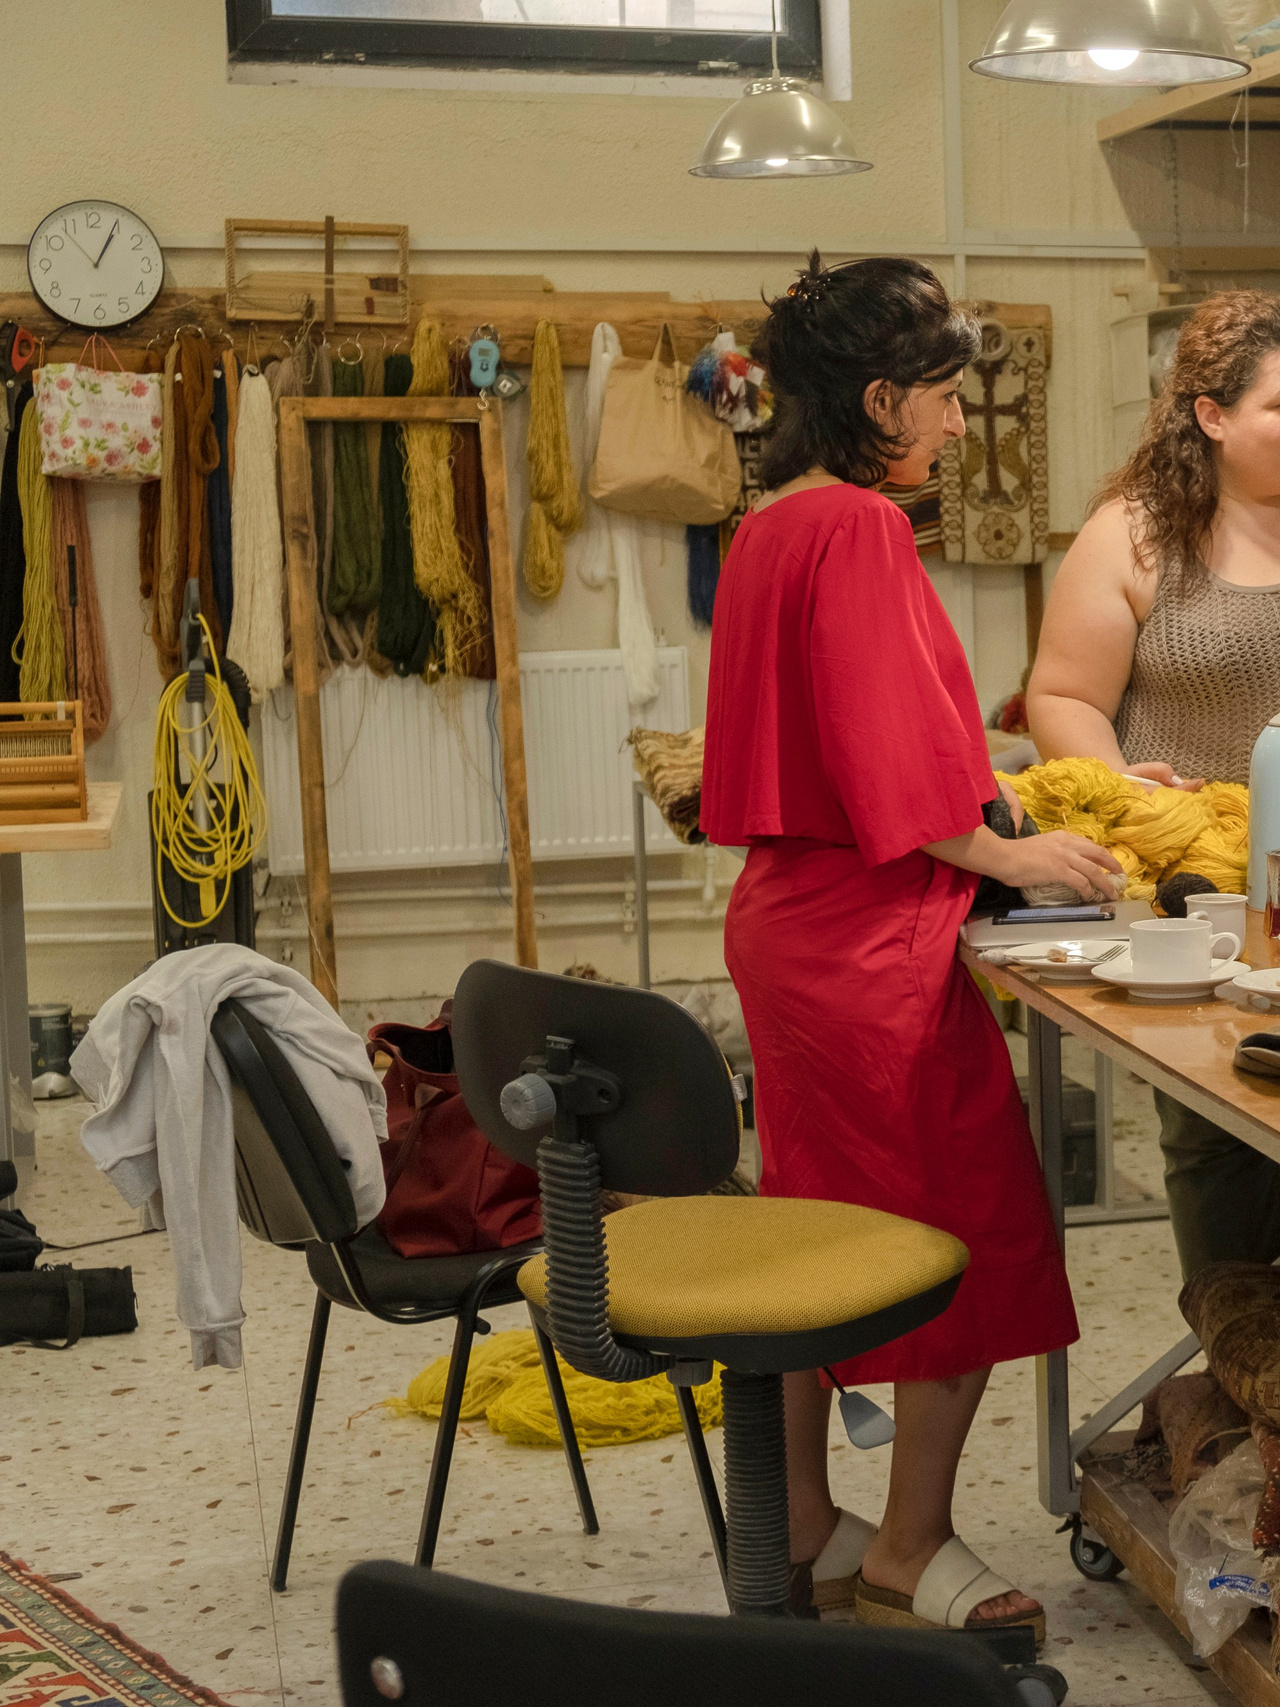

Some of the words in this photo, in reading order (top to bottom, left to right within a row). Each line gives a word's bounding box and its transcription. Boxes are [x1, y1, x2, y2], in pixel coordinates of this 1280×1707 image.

[63, 218, 76, 235] 11
[84, 211, 101, 229] 12
[45, 234, 65, 252] 10
[130, 233, 143, 251] 2
[39, 257, 52, 275] 9
[141, 256, 152, 274] 3
[49, 281, 61, 298] 8
[134, 280, 146, 296] 4
[69, 297, 81, 315] 7
[93, 303, 106, 320] 6
[117, 297, 130, 314] 5
